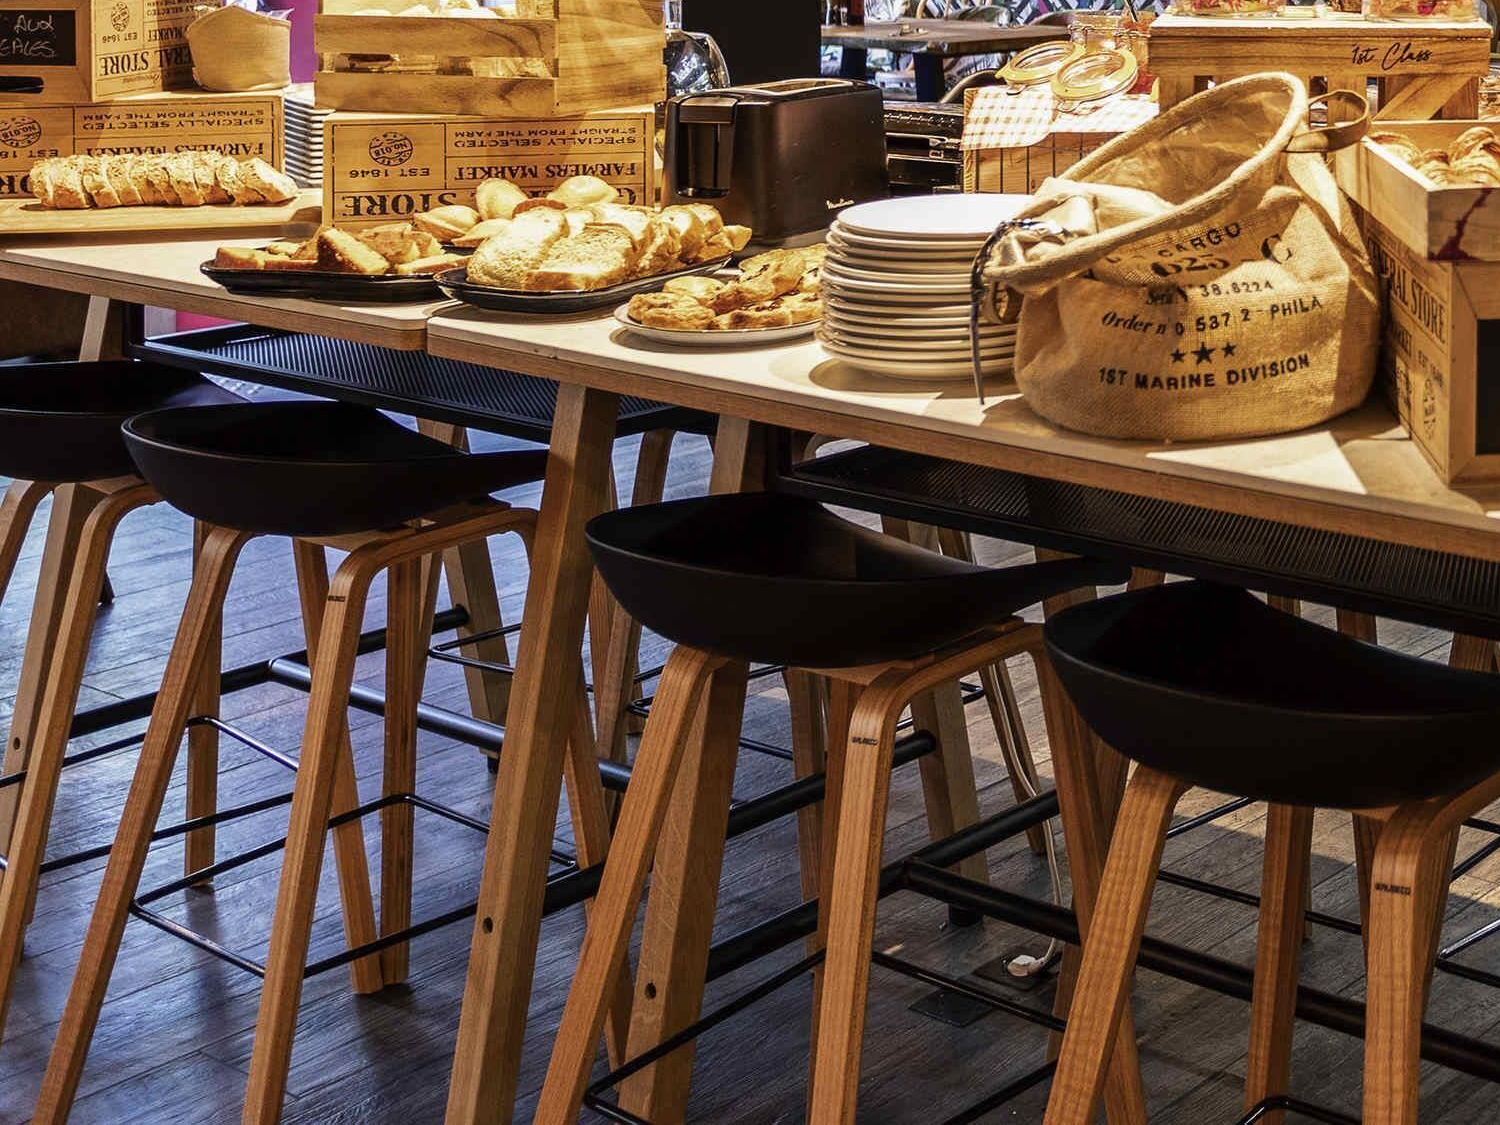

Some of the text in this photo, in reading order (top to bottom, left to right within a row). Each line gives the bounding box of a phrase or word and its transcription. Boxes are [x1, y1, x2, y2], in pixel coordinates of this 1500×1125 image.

[99, 51, 149, 76] STORE
[1352, 42, 1433, 71] 1st Class
[82, 117, 264, 131] SPECIALLY SELECTED
[124, 112, 151, 120] THE
[454, 127, 636, 138] STRAIGHT FROM THE FARM
[454, 135, 636, 148] SPECIALLY SELECTED
[28, 149, 59, 158] EST
[349, 168, 430, 179] EST 1846
[454, 162, 636, 180] FARMERS MARKET
[342, 192, 457, 217] STORE
[1158, 222, 1241, 257] CARGO
[1102, 311, 1153, 334] Order
[1196, 312, 1231, 332] 537
[1270, 295, 1322, 319] PHILA
[1411, 277, 1446, 343] STORE
[1098, 352, 1310, 390] 1ST MARINE DIVISION
